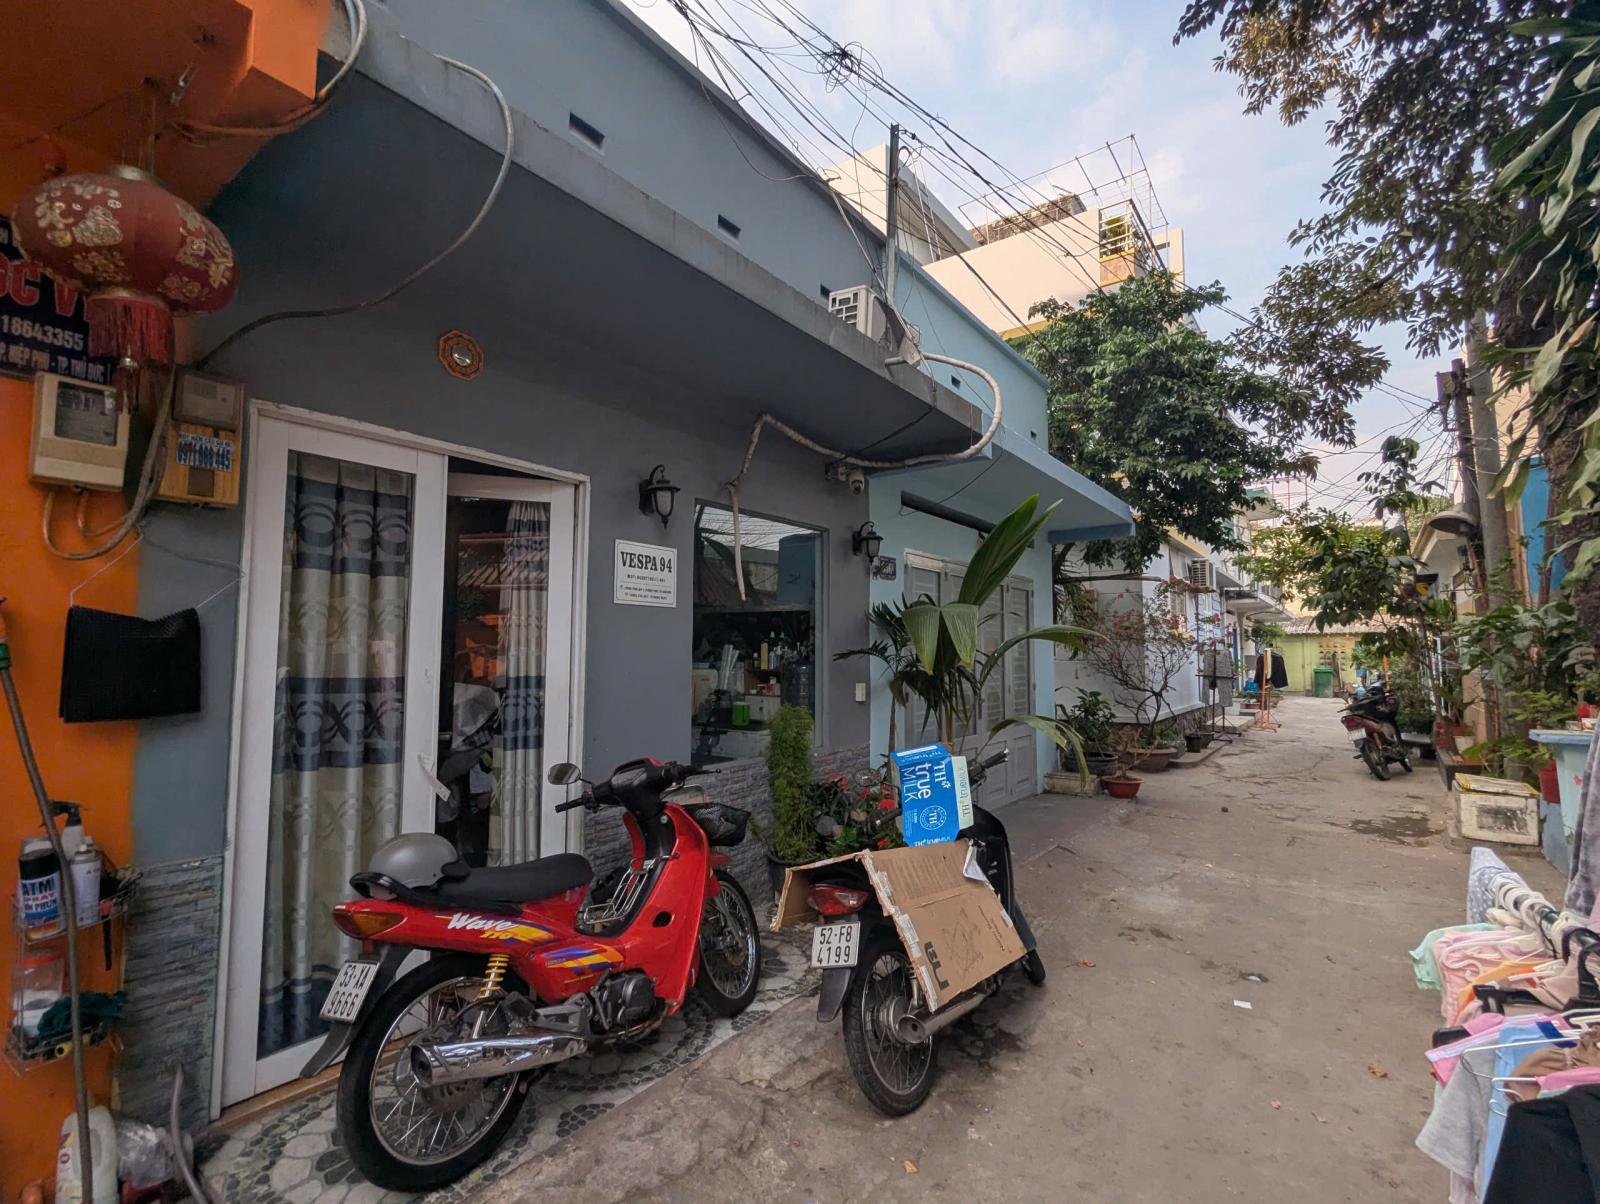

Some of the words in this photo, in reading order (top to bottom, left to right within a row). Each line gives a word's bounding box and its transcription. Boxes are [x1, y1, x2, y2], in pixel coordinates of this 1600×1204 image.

[620, 551, 658, 571] VESPA
[659, 556, 673, 573] 94
[915, 761, 932, 799] true
[933, 760, 947, 782] TH
[901, 766, 919, 803] MILK
[447, 912, 519, 932] Wave
[816, 945, 851, 965] 4199
[327, 990, 359, 1017] 9666
